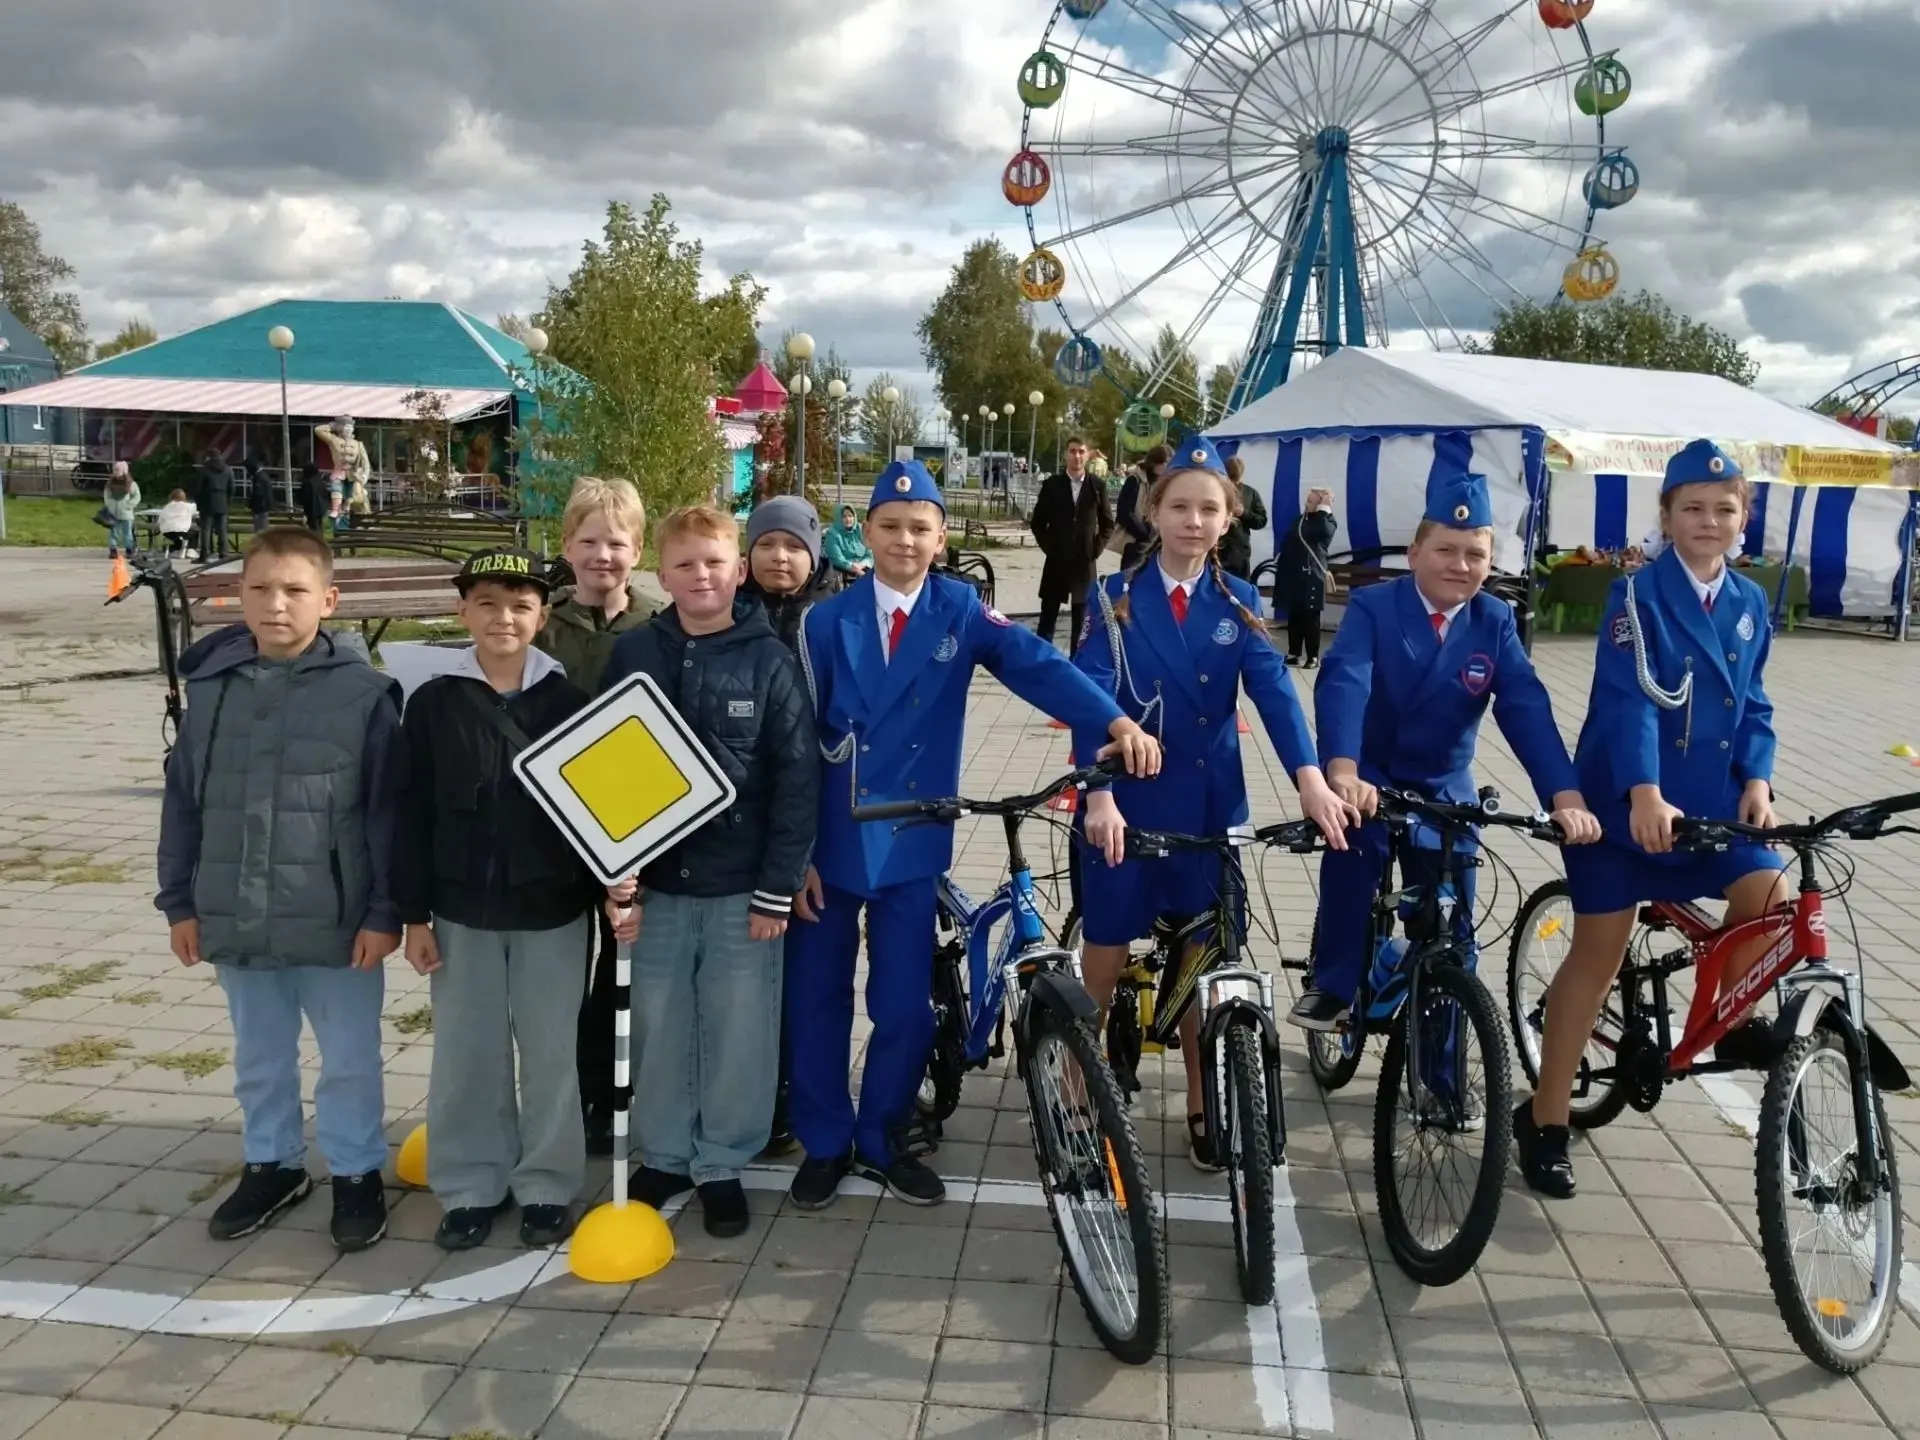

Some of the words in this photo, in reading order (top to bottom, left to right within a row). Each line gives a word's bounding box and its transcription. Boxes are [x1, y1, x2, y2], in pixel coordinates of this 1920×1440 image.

[1611, 439, 1684, 454] ЯРМАРК
[471, 553, 529, 574] URBAN
[1717, 930, 1794, 1022] CROSS
